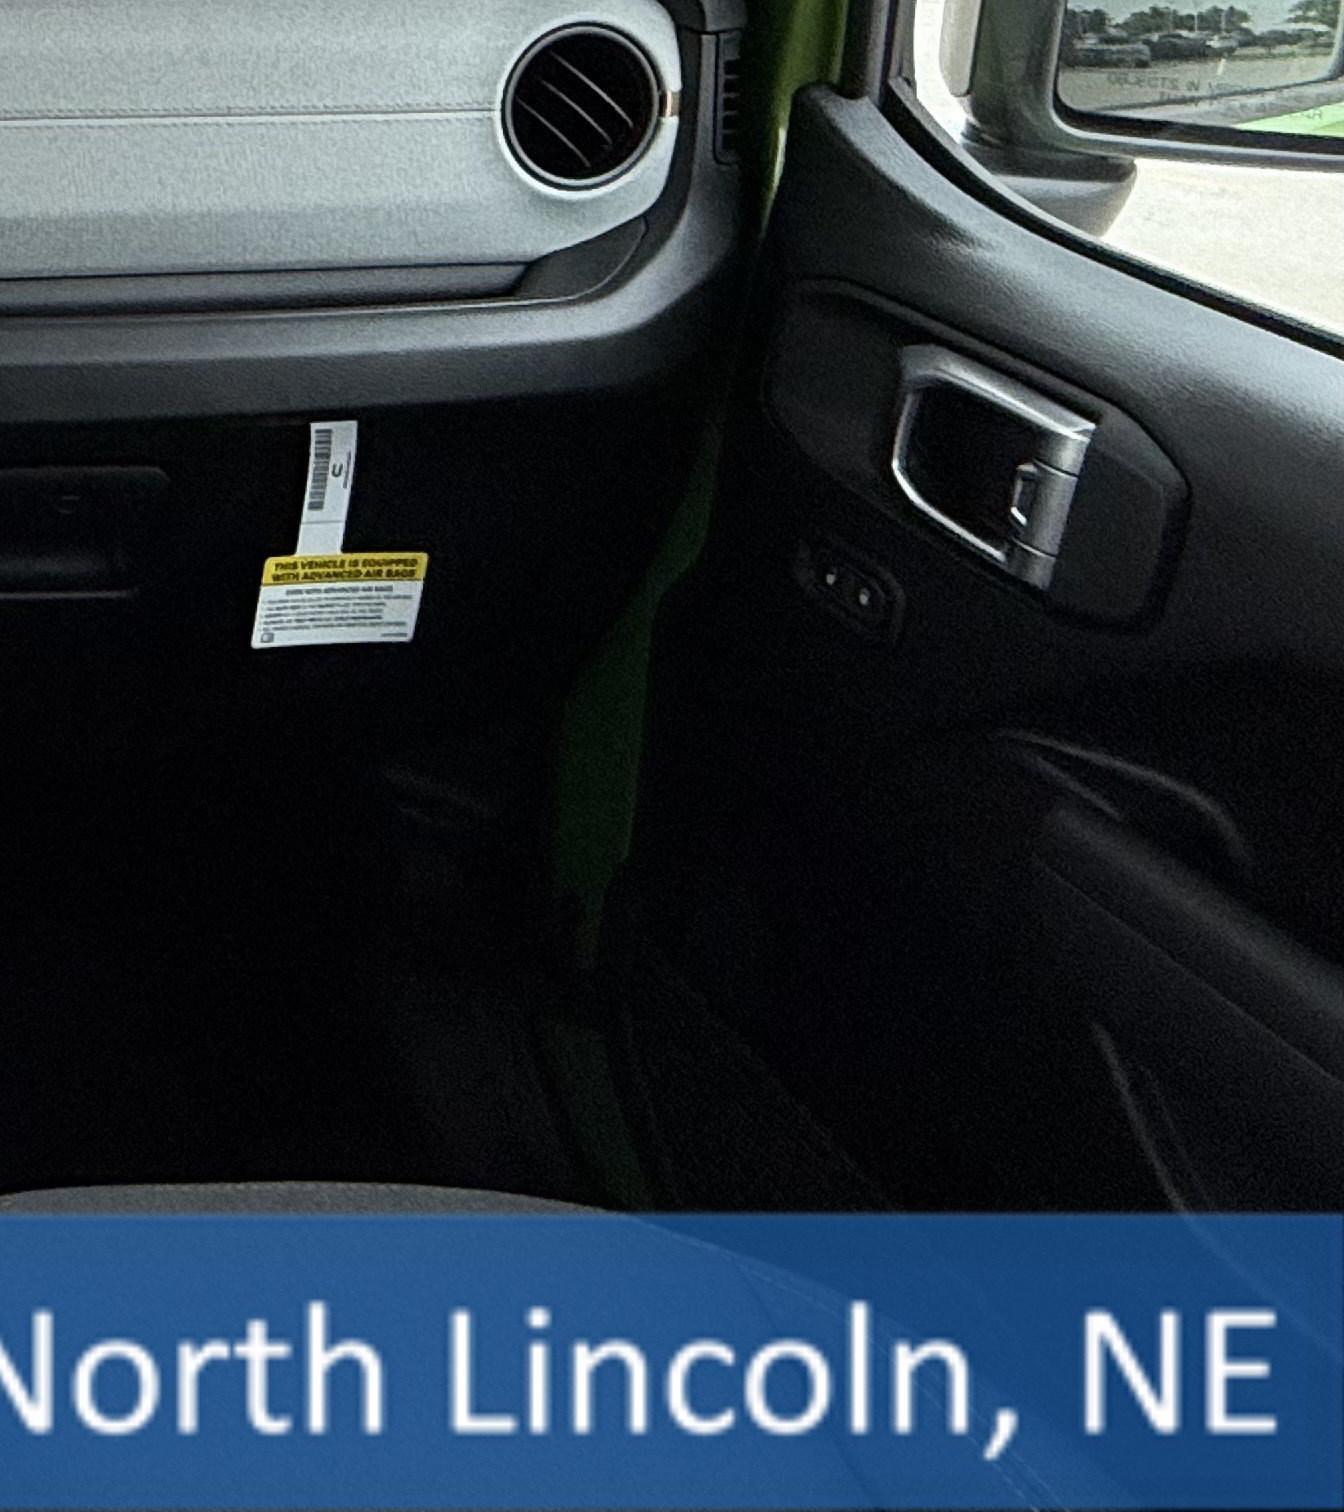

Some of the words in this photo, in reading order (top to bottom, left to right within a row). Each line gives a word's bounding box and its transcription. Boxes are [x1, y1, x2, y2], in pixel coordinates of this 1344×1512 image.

[301, 560, 345, 569] VEHICLE
[301, 570, 362, 580] ADVANCED
[364, 569, 383, 578] AIR
